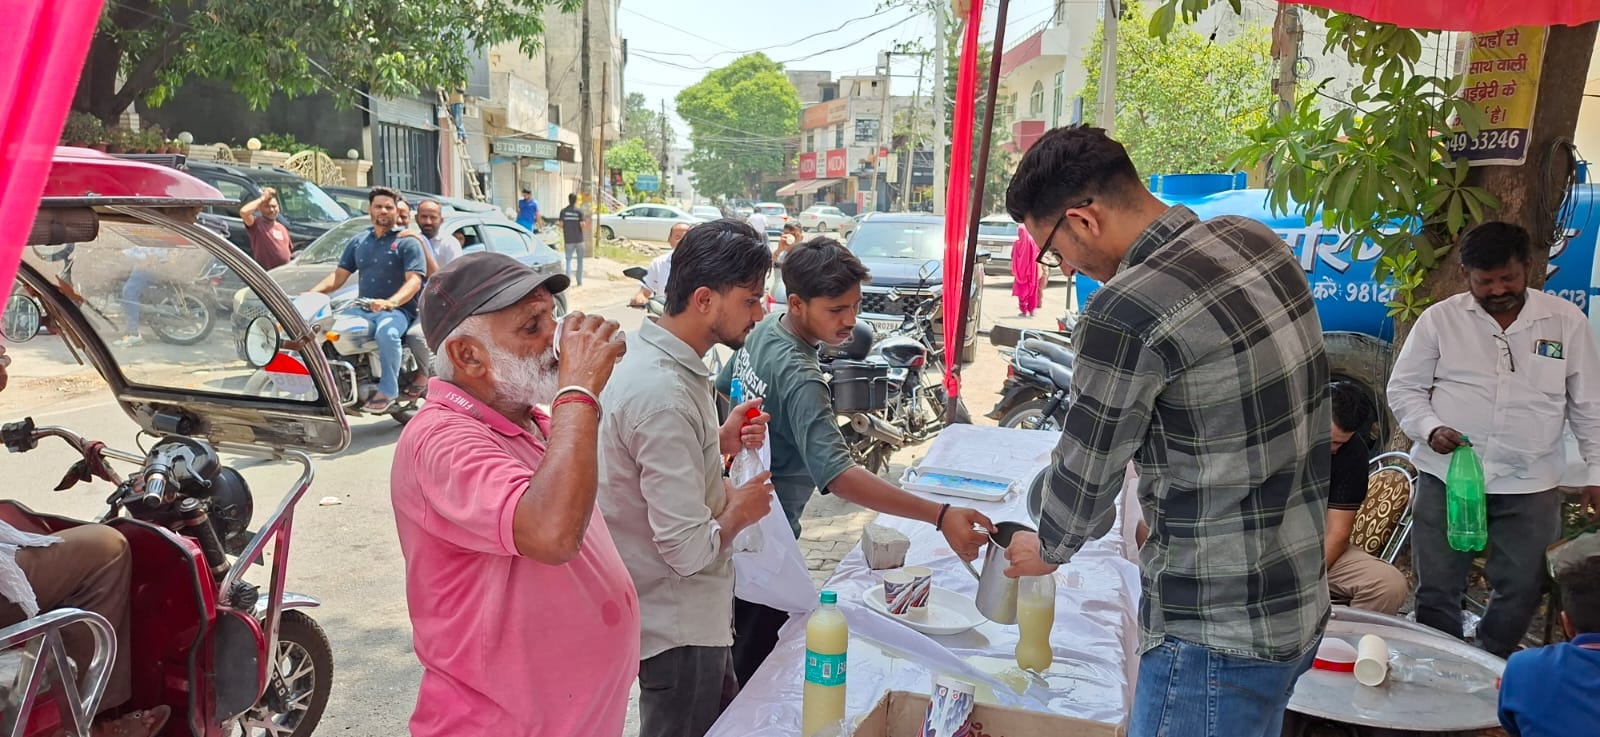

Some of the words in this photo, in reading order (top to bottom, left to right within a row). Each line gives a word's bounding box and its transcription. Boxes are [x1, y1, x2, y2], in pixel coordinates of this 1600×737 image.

[1507, 28, 1520, 46] से
[1469, 60, 1494, 74] साथ
[1497, 54, 1527, 71] वाली
[1503, 80, 1517, 97] के
